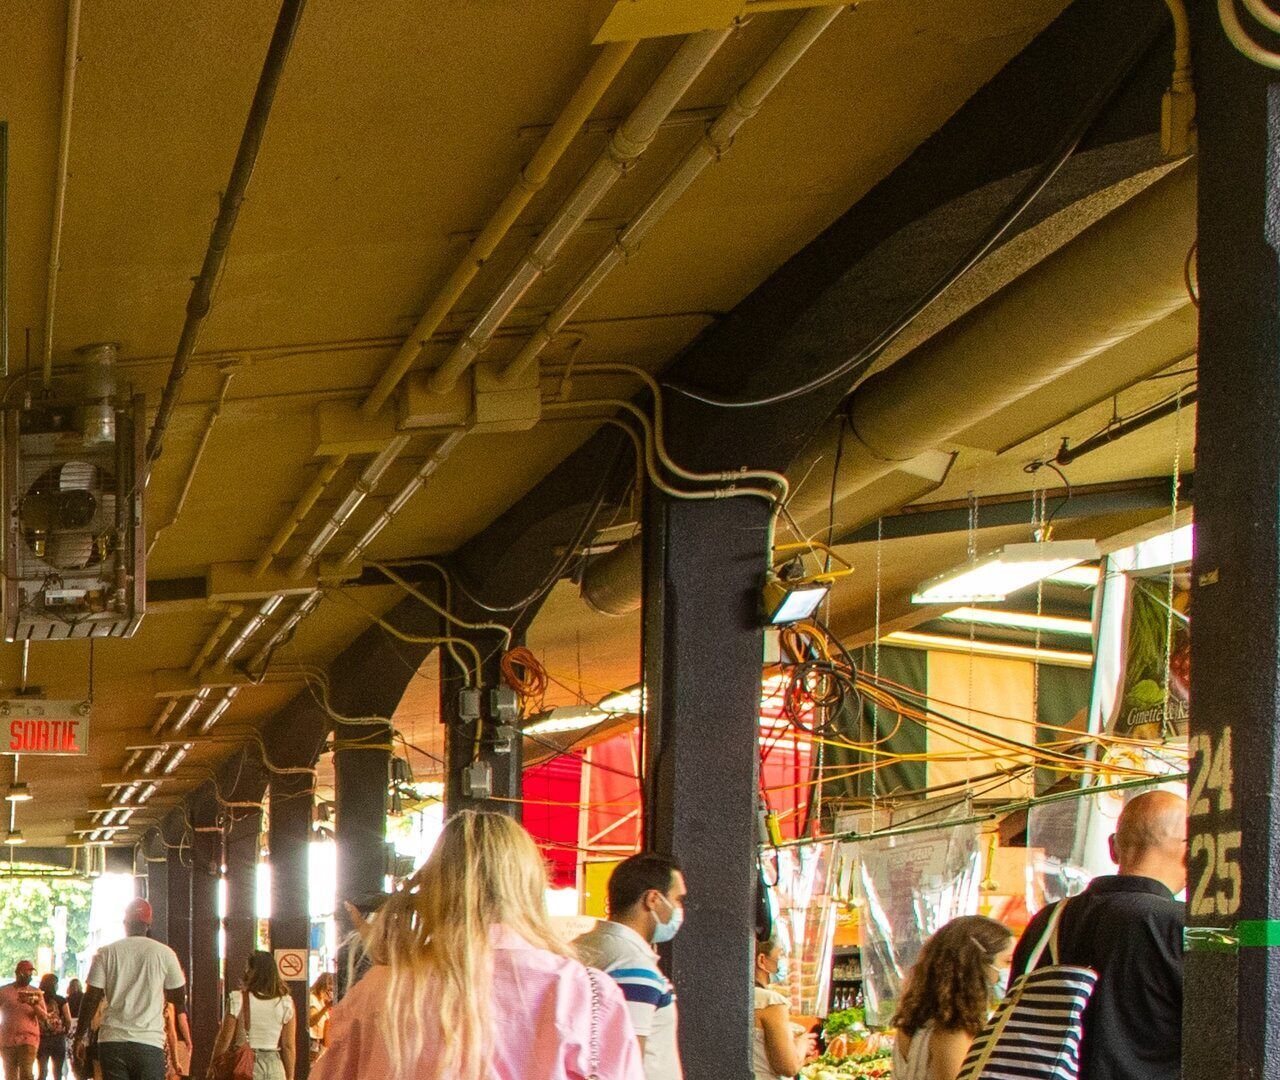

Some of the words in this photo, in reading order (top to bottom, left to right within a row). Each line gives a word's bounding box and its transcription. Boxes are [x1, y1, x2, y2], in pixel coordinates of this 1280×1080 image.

[9, 719, 81, 751] SORTIE
[1187, 725, 1232, 816] 24
[1190, 831, 1242, 917] 25
